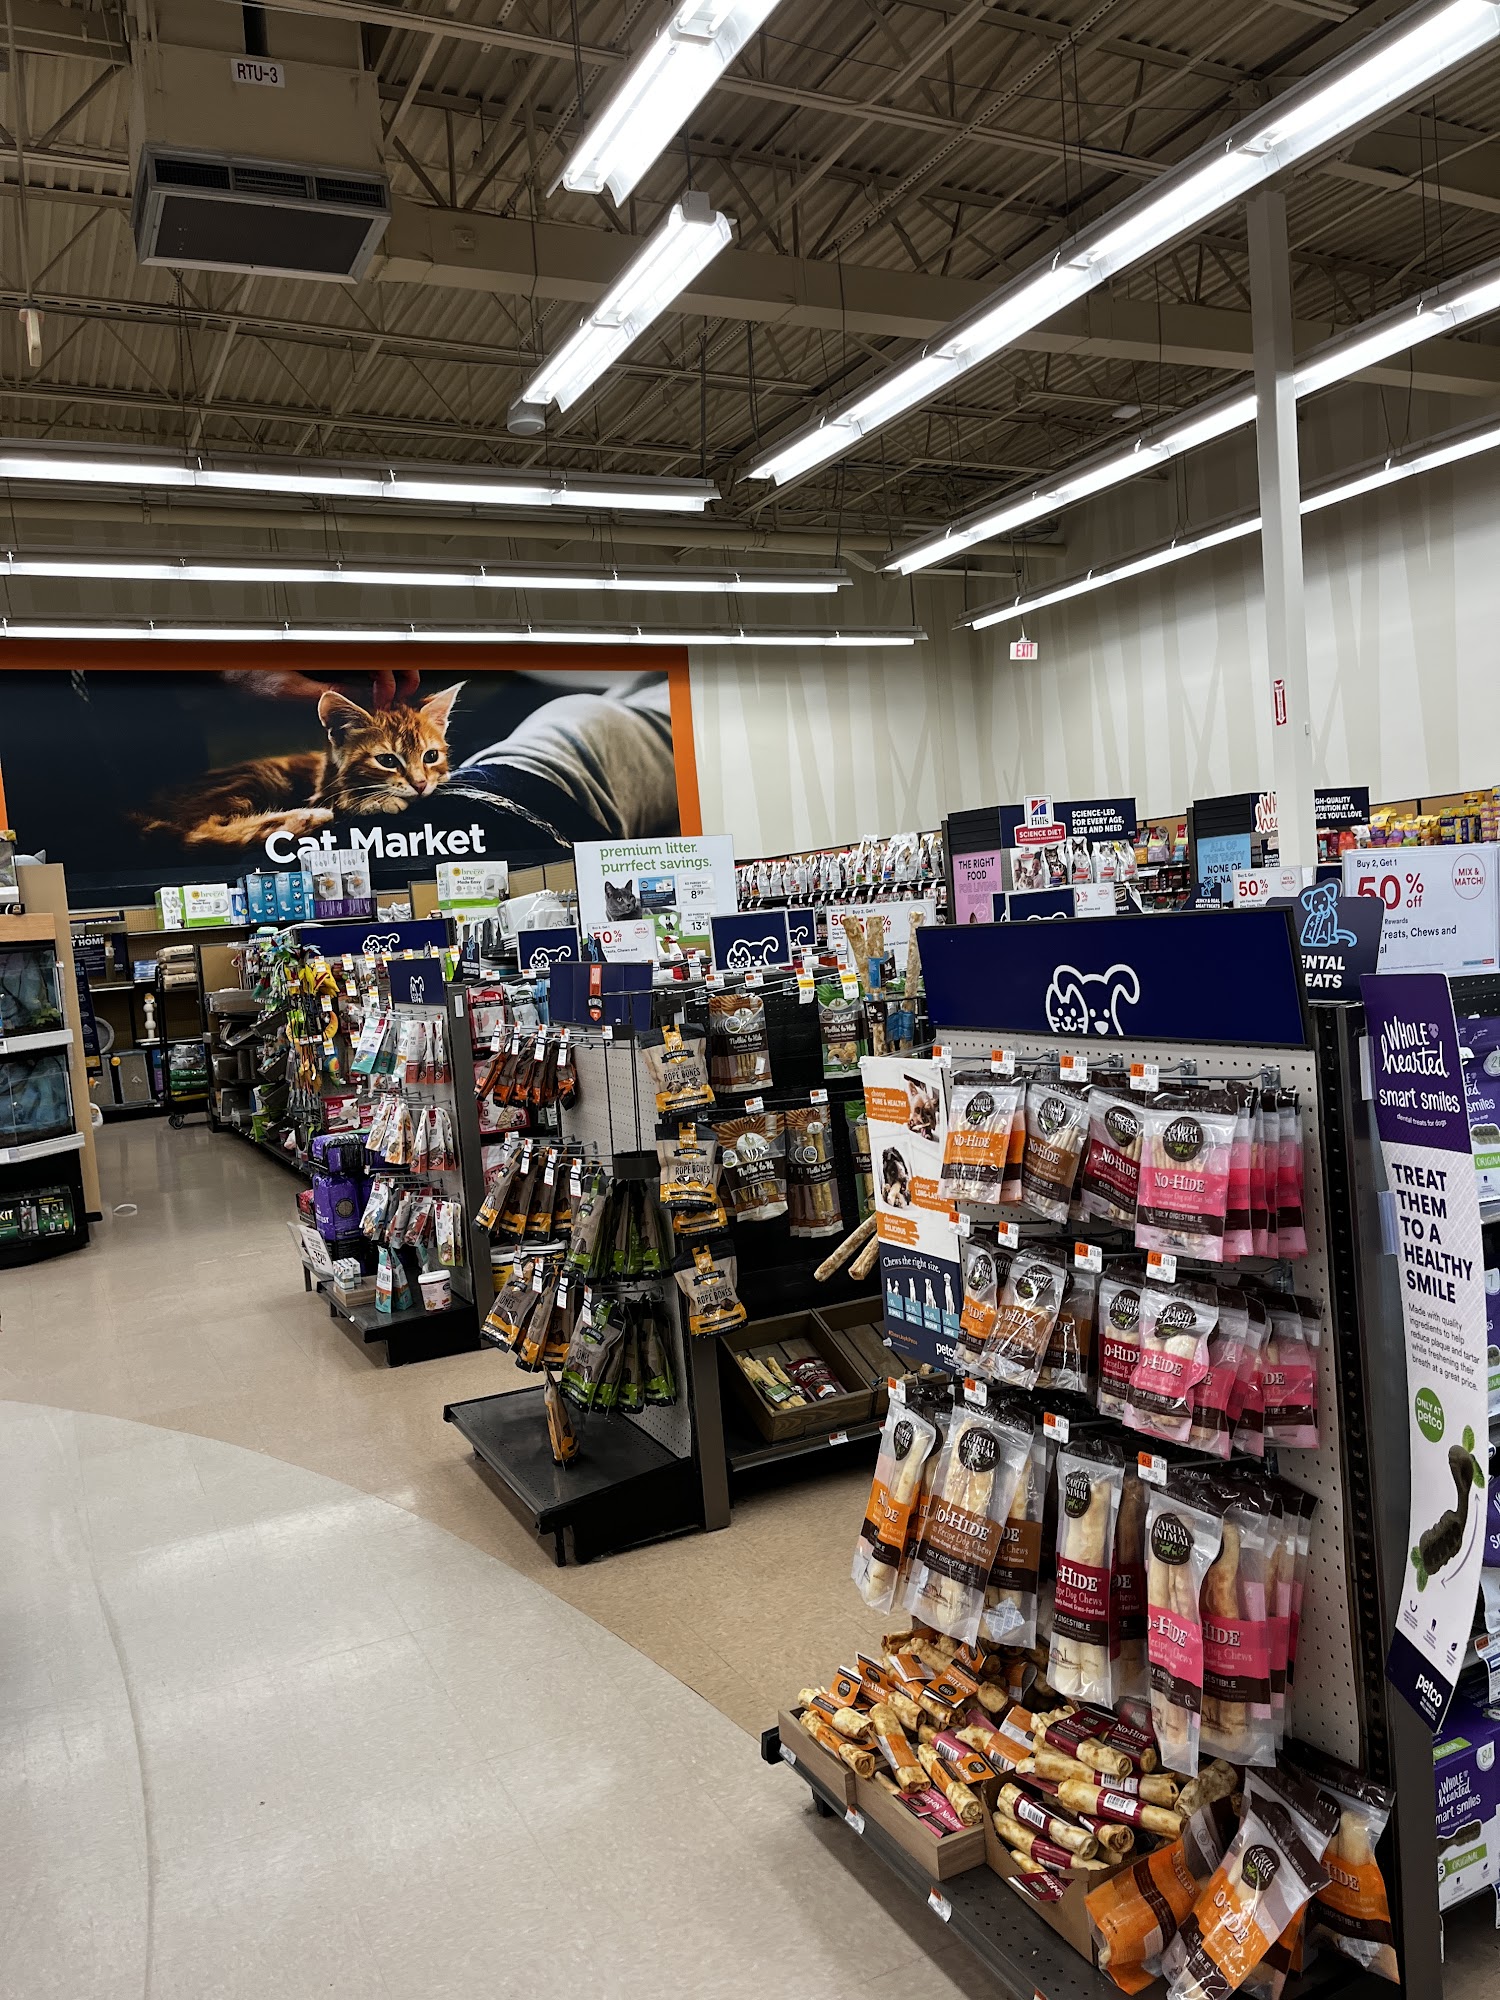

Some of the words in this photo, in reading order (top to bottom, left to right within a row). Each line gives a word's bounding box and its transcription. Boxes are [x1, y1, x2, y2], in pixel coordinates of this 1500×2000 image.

[237, 63, 278, 83] RTU-3
[1015, 643, 1034, 658] EXIT
[1031, 816, 1049, 826] Hill's
[1071, 808, 1116, 818] SCIENCE-LED
[1072, 818, 1086, 826] FOR
[1086, 817, 1107, 826] EVERY
[1108, 816, 1125, 825] AGE,
[1019, 830, 1046, 838] SCIENCE
[1047, 828, 1062, 837] DIET
[1073, 826, 1088, 834] SIZE
[1088, 825, 1104, 833] AND
[1104, 824, 1123, 833] NEED
[265, 830, 337, 863] Cat
[350, 823, 486, 859] Market
[600, 844, 662, 860] premium
[665, 842, 698, 854] litter.
[601, 859, 656, 876] purrfect
[660, 857, 712, 871] savings.
[958, 860, 972, 870] THE
[973, 857, 995, 867] RIGHT
[1207, 864, 1229, 873] NONE
[1356, 859, 1370, 868] Buy
[1371, 859, 1379, 868] 2,
[1380, 858, 1393, 867] Get
[1394, 858, 1398, 866] 1
[1458, 868, 1473, 876] MIX
[1474, 867, 1480, 875] &
[967, 870, 987, 881] FOOD
[1454, 877, 1484, 886] MATCH!
[1406, 895, 1423, 908] off
[1410, 928, 1440, 937] Chews
[1441, 925, 1457, 934] and
[78, 937, 105, 946] HOME
[1304, 973, 1342, 989] EATS
[1384, 1015, 1430, 1050] WHOLE
[664, 1070, 680, 1082] ROPE
[682, 1067, 701, 1079] BONES
[1379, 1088, 1418, 1109] smart
[1421, 1091, 1461, 1113] smiles
[1170, 1123, 1199, 1135] EARTH
[1397, 1113, 1412, 1124] dental
[1412, 1117, 1427, 1127] treats
[1434, 1119, 1447, 1128] dogs
[1165, 1132, 1200, 1143] ANIMAL
[675, 1165, 691, 1175] ROPE
[692, 1164, 711, 1174] BONES
[1099, 1147, 1138, 1180] NO-HIDE
[1154, 1172, 1206, 1193] NO-HIDE
[1391, 1163, 1447, 1191] TREAT
[1396, 1189, 1448, 1219] THEM
[1169, 1211, 1202, 1223] DIGESTIBLE
[1400, 1215, 1424, 1240] TO
[1429, 1223, 1442, 1245] A
[883, 1257, 902, 1267] Chews
[902, 1255, 912, 1266] the
[912, 1257, 927, 1269] right
[927, 1261, 940, 1273] size.
[1403, 1242, 1473, 1281] HEALTHY
[1406, 1269, 1456, 1304] SMILE
[697, 1292, 713, 1305] ROPE
[714, 1287, 733, 1300] BONES
[1408, 1303, 1426, 1317] Made
[1426, 1311, 1441, 1321] with
[1442, 1317, 1463, 1331] quality
[1409, 1315, 1442, 1336] ingredients
[1443, 1329, 1450, 1339] to
[1451, 1331, 1465, 1345] help
[1410, 1329, 1430, 1343] reduce
[1431, 1336, 1450, 1353] plaque
[1451, 1346, 1462, 1357] and
[1463, 1350, 1480, 1364] tartar
[1411, 1342, 1427, 1355] while
[1428, 1348, 1459, 1371] freshening
[1460, 1362, 1474, 1375] their
[1411, 1353, 1431, 1370] breath
[1432, 1363, 1439, 1372] at
[1439, 1367, 1443, 1375] a
[1444, 1369, 1460, 1383] great
[1461, 1377, 1478, 1391] price.
[1416, 1397, 1433, 1411] ONLY
[1433, 1405, 1441, 1416] AT
[1417, 1409, 1442, 1430] petco
[966, 1433, 995, 1449] EARTH
[1156, 1518, 1187, 1537] EARTH
[1065, 1587, 1077, 1603] Dog
[1079, 1590, 1103, 1606] Chews
[1058, 1614, 1091, 1632] DIGESTIBLE
[1415, 1673, 1443, 1708] petco
[1456, 1794, 1481, 1815] smiles
[1452, 1851, 1479, 1870] ORIGINAL
